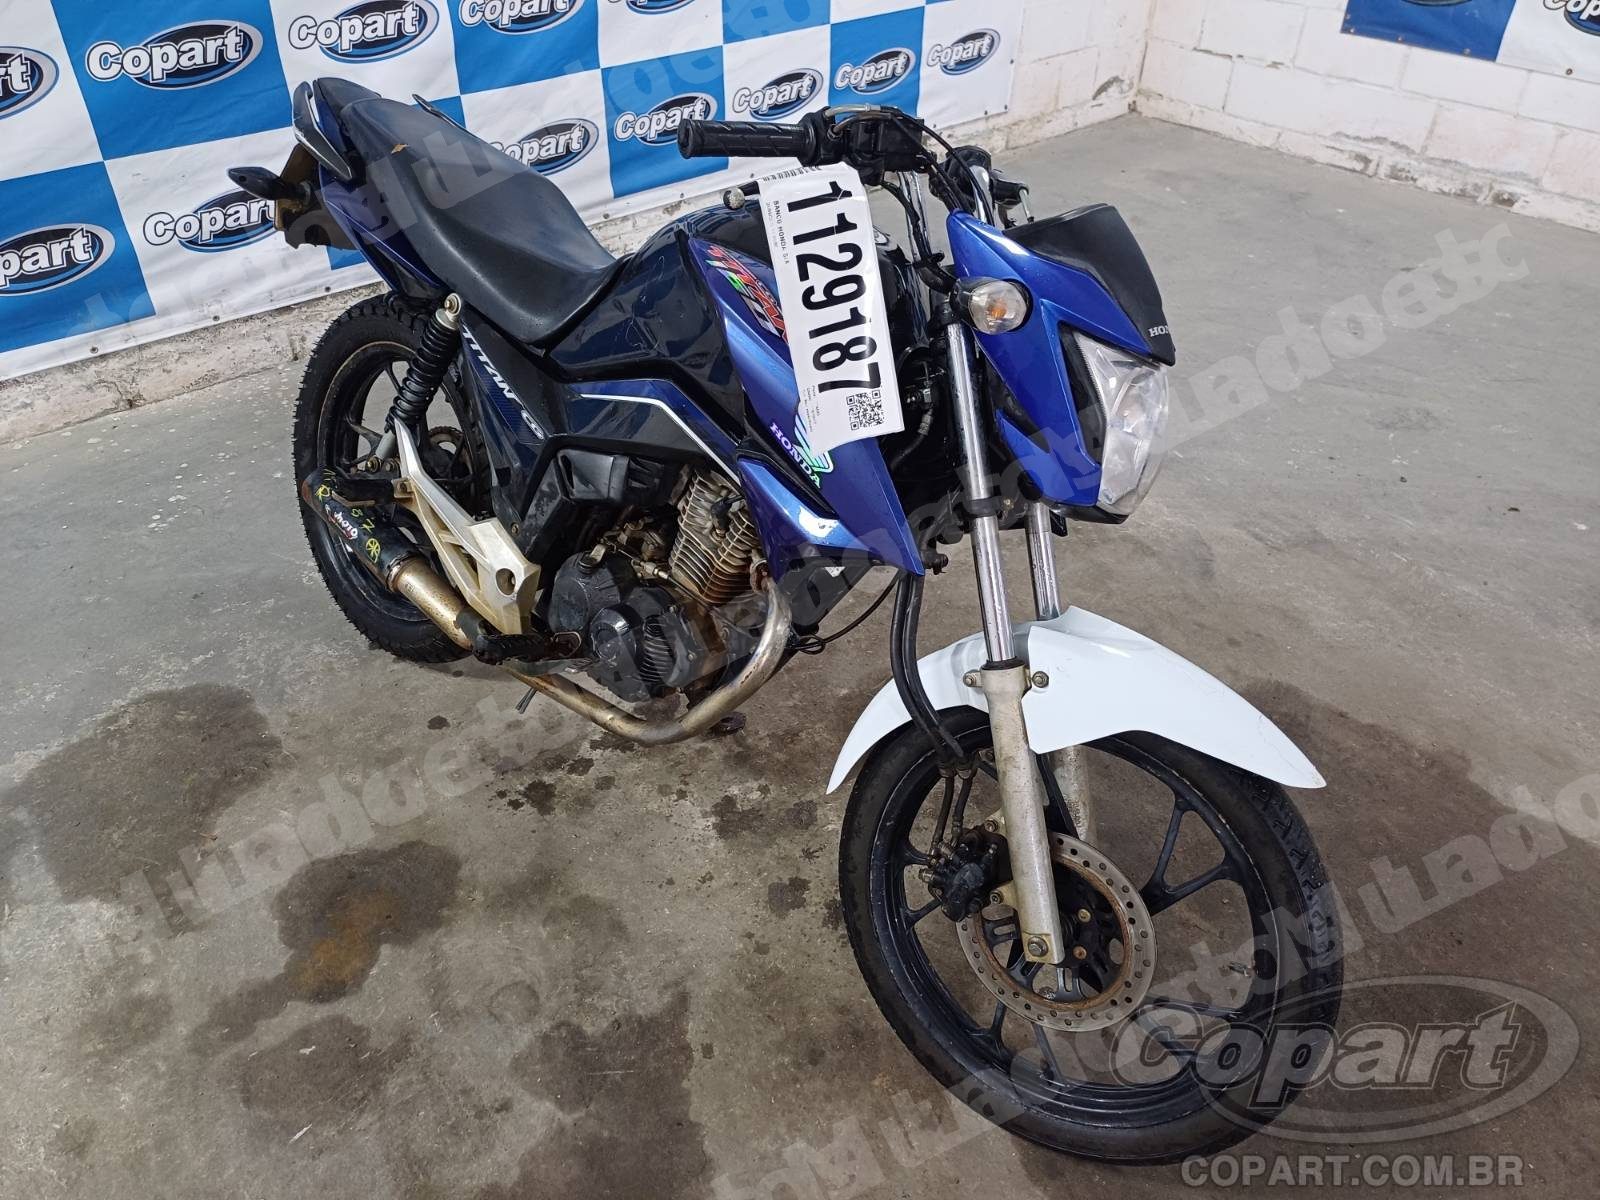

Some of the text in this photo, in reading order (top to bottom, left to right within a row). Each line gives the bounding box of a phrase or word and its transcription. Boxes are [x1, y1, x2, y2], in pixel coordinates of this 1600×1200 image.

[86, 24, 244, 82] Copart
[288, 1, 419, 53] Copart
[926, 33, 993, 68] Copart
[732, 74, 816, 114] Copart
[834, 51, 909, 91] Copart
[489, 122, 584, 168] opart
[0, 226, 94, 288] part
[787, 181, 881, 394] 1129187
[462, 323, 526, 410] TITAN
[769, 422, 821, 489] HONDA
